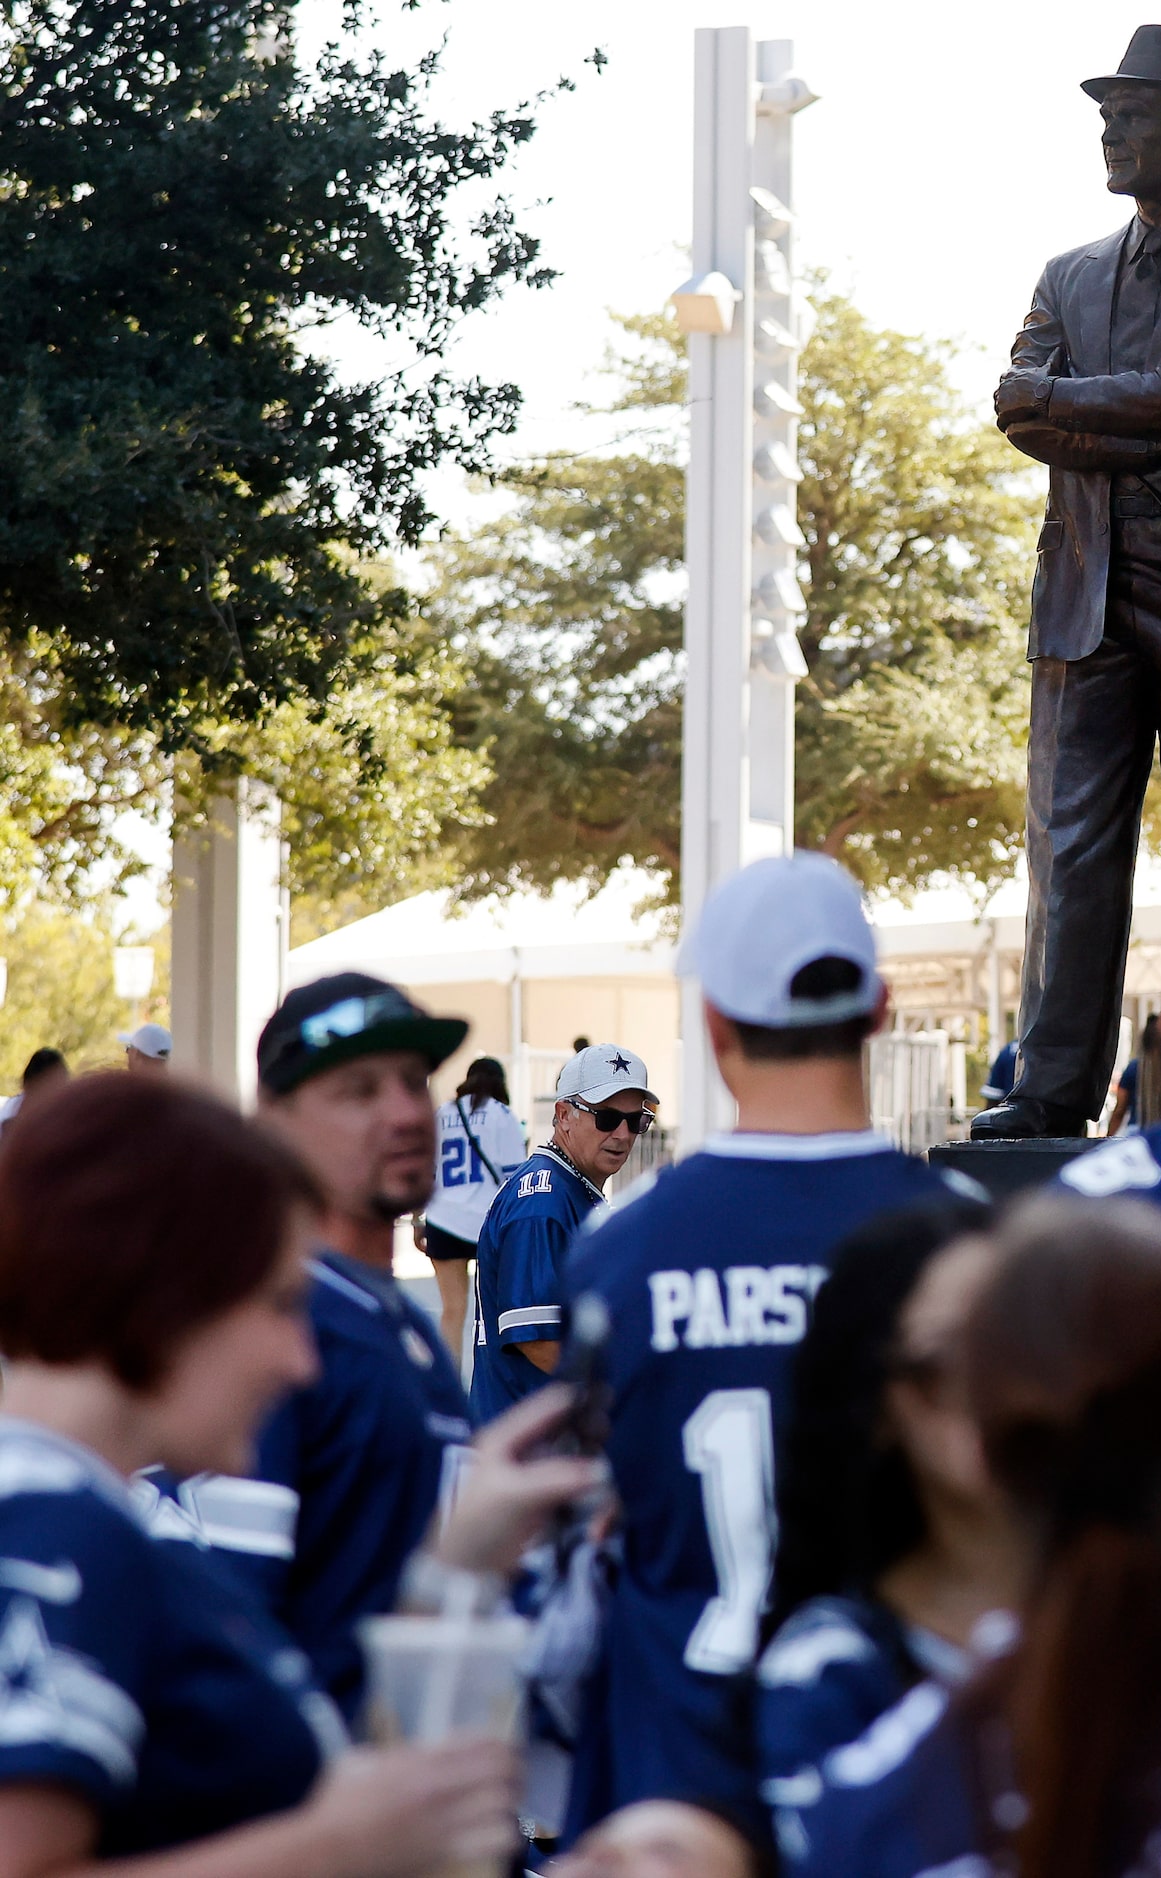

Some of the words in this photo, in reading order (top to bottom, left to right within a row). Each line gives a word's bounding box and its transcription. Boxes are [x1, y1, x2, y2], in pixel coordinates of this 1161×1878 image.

[442, 1135, 484, 1187] 21
[518, 1169, 552, 1198] 11
[648, 1265, 829, 1352] PARS
